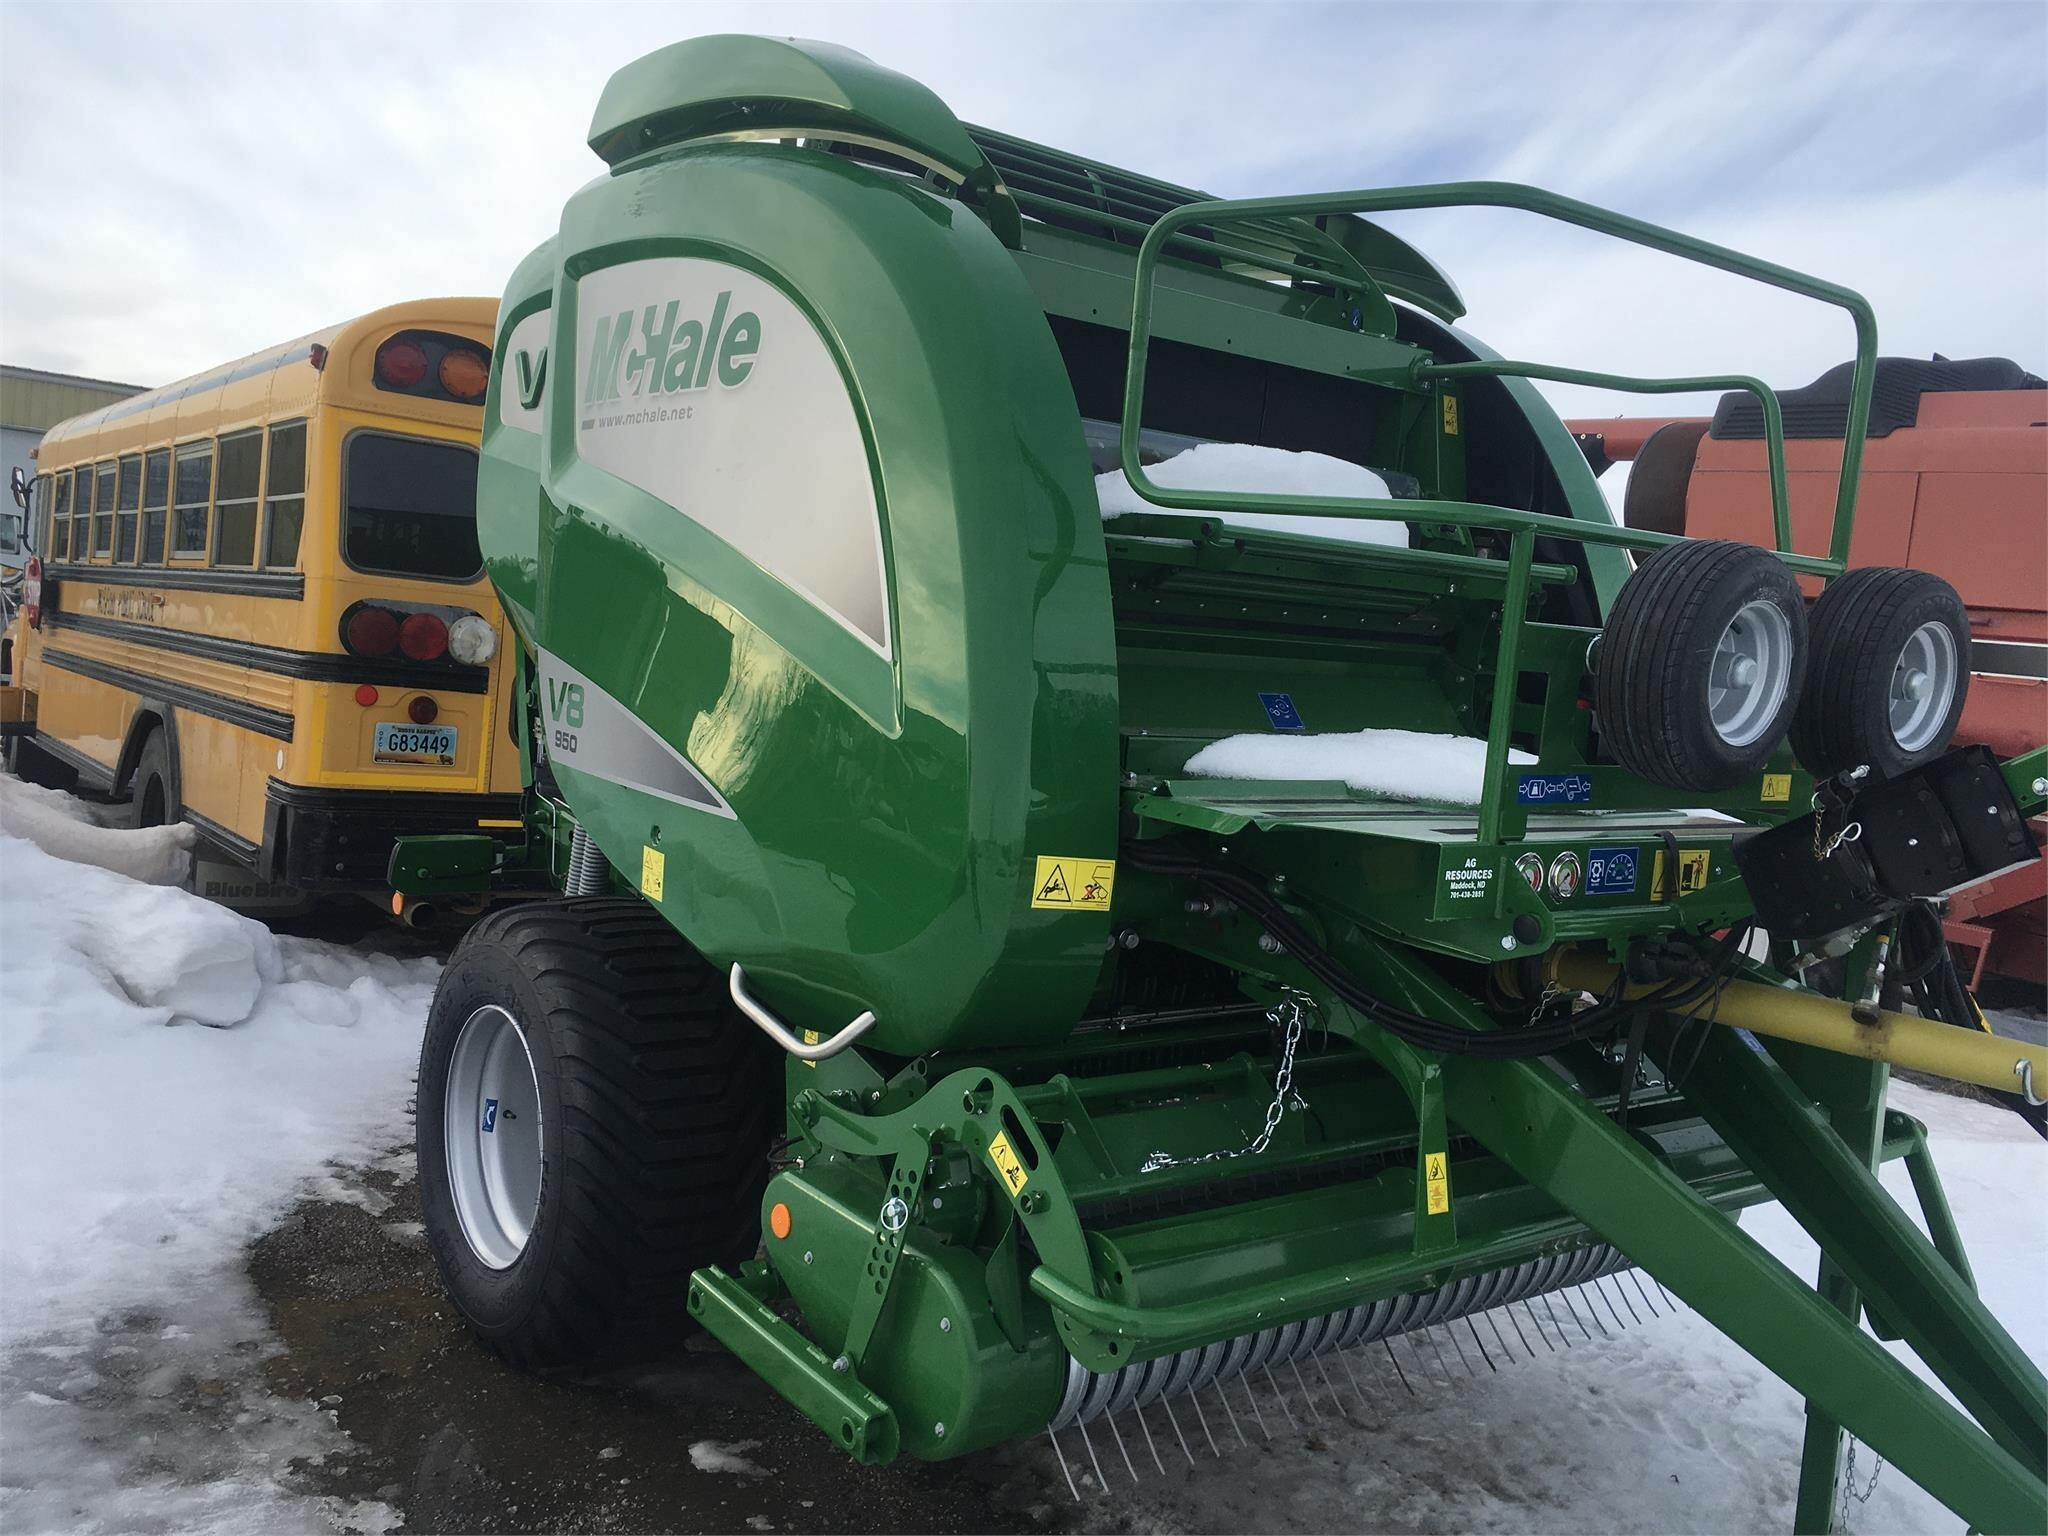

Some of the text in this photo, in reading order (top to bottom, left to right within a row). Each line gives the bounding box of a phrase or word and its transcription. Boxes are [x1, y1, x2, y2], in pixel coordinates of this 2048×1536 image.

[584, 291, 762, 402] McHale
[598, 406, 694, 428] www.mchale.net
[548, 677, 585, 729] V8
[388, 733, 449, 754] G83449
[554, 729, 578, 754] 950
[1464, 857, 1477, 868] AG
[1445, 869, 1493, 881] RESOURCES
[1450, 880, 1486, 890] Maddock, ND
